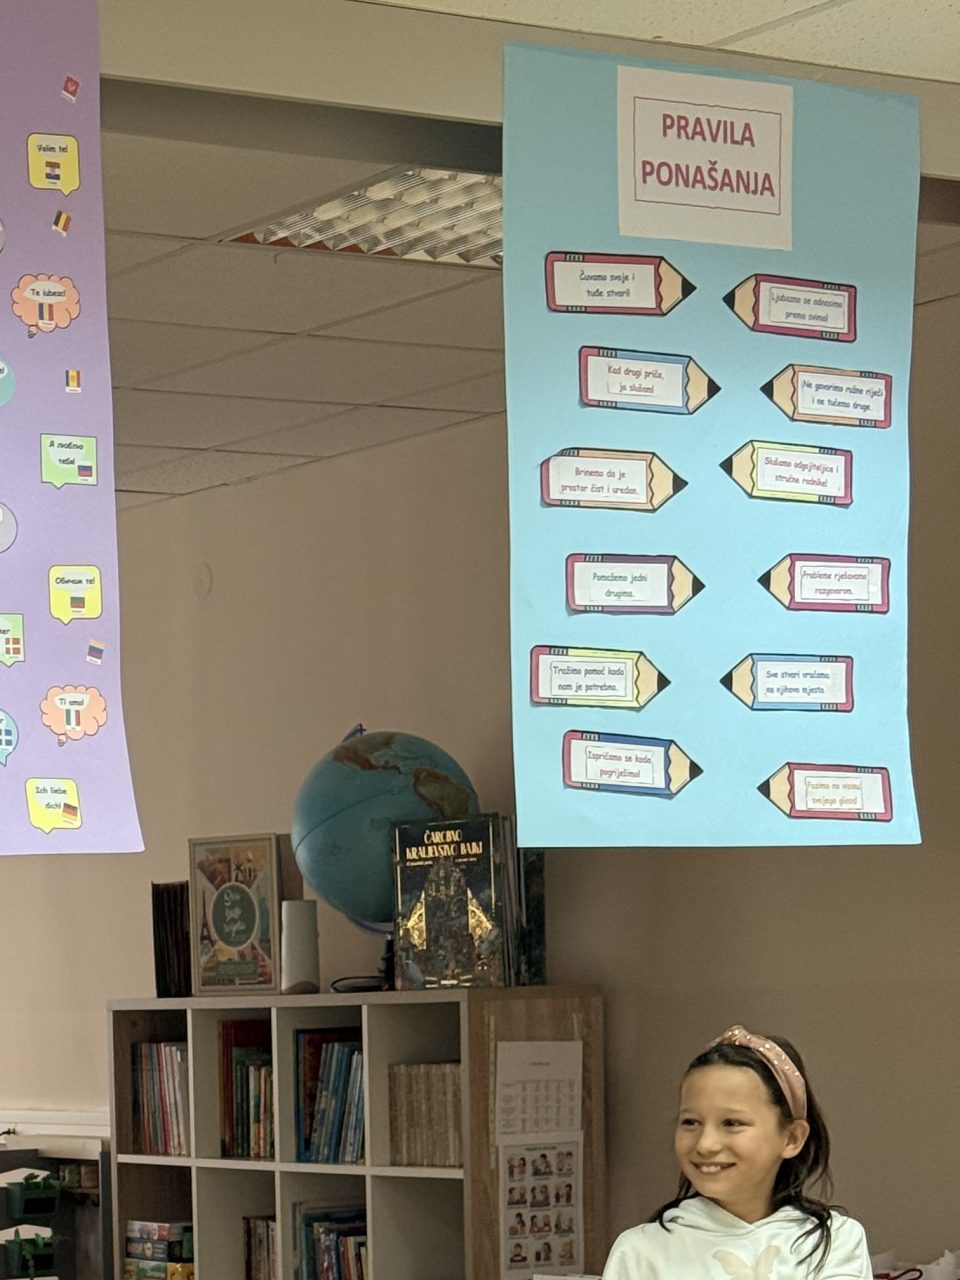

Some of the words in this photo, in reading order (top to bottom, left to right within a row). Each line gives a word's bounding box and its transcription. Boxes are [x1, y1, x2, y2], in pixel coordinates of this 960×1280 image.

[662, 113, 756, 148] PRAVILA
[641, 159, 775, 198] PONAŠANJA
[579, 271, 607, 281] Čuvamo
[610, 272, 630, 284] svoje
[31, 288, 41, 298] Te
[624, 366, 642, 378] drugi
